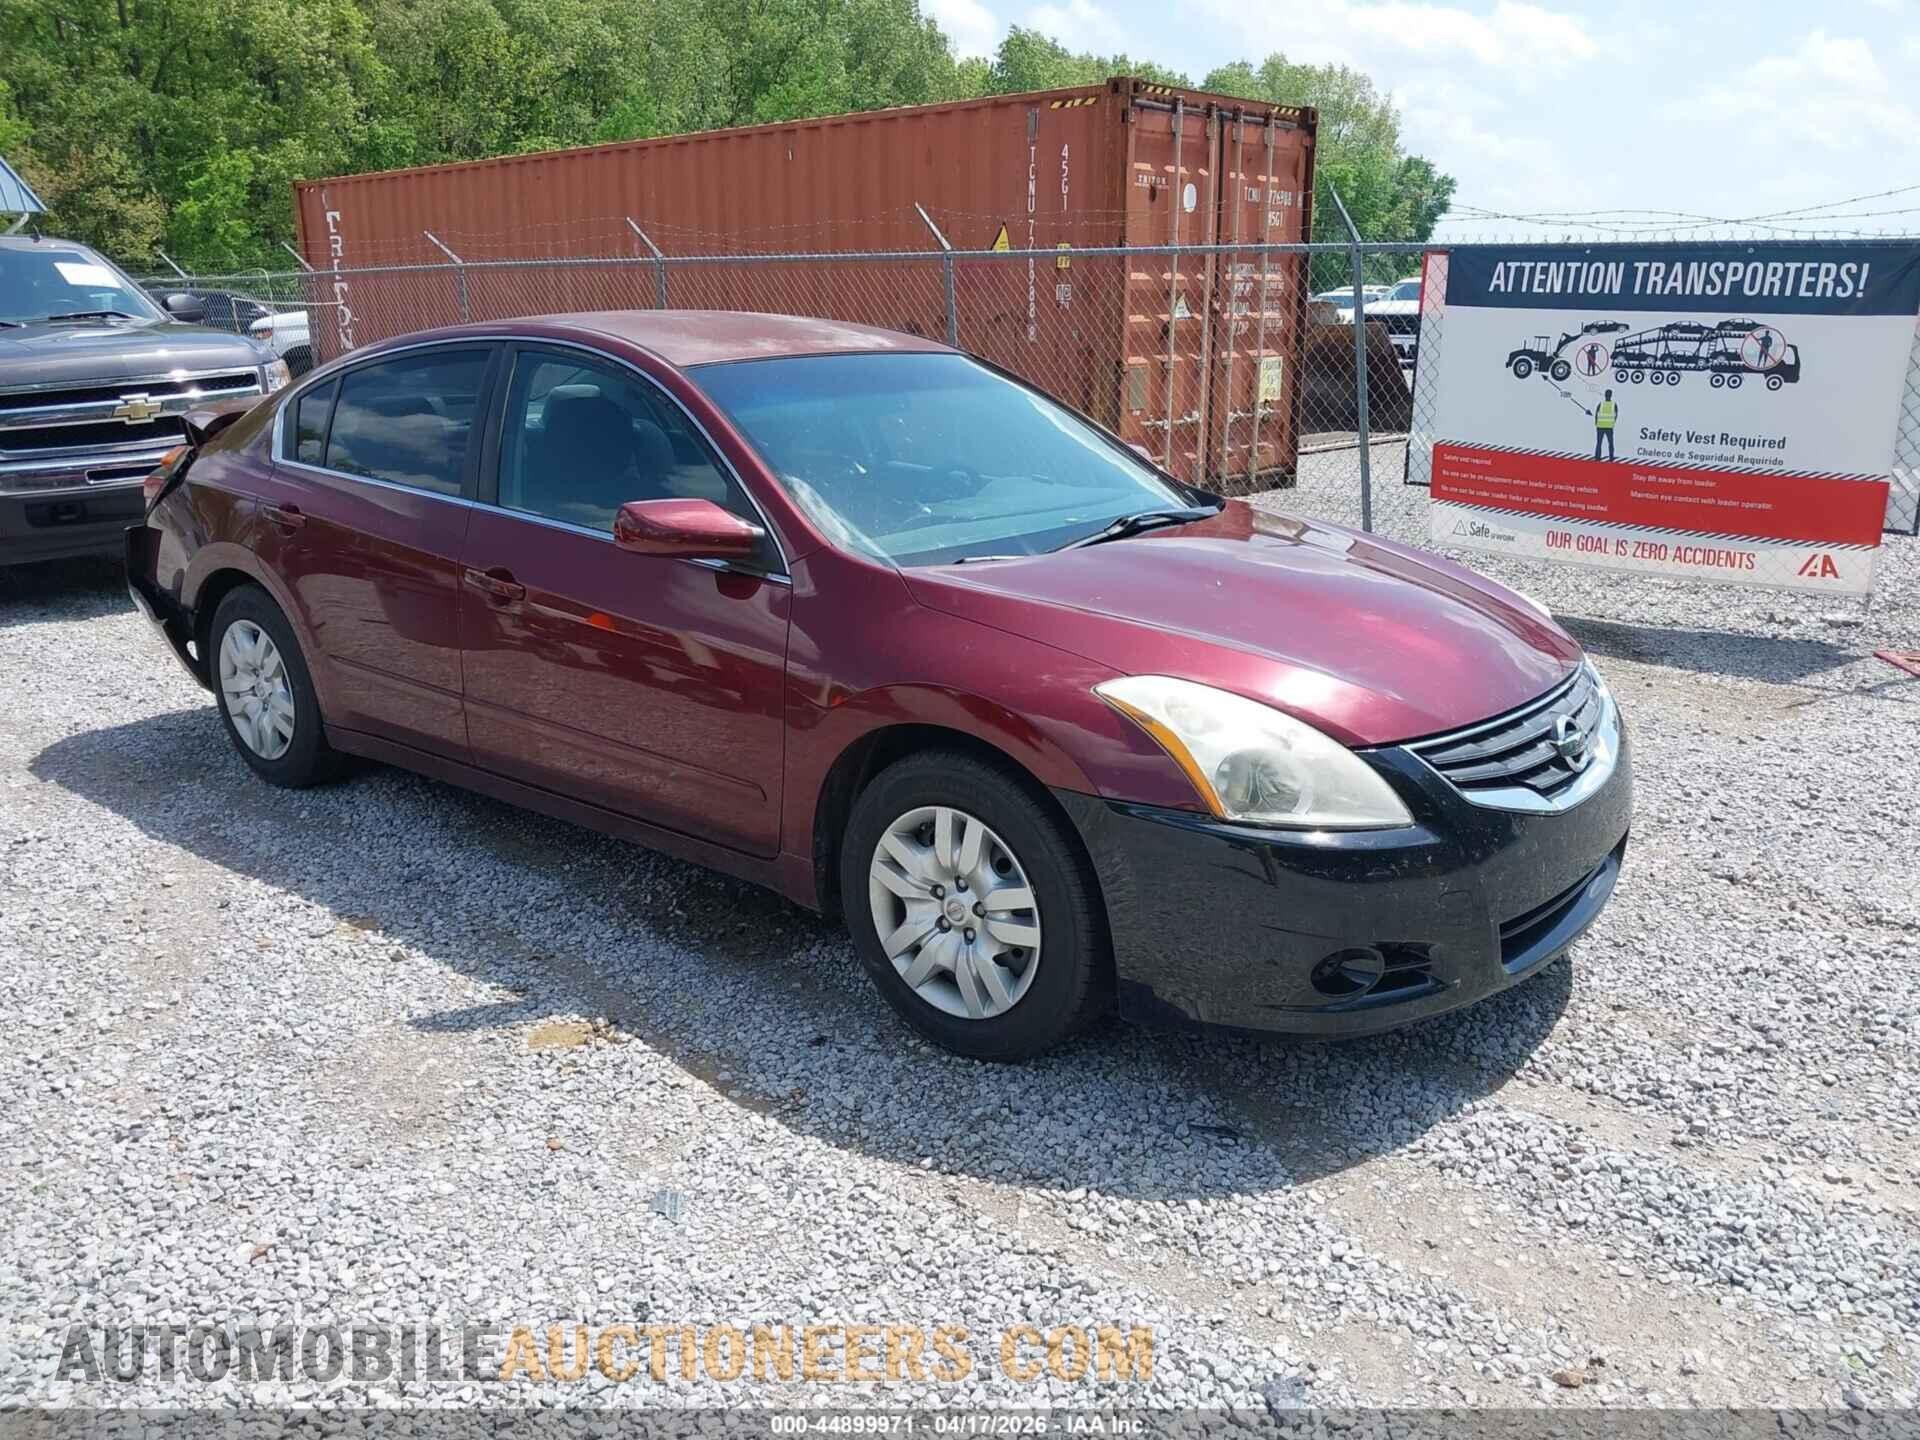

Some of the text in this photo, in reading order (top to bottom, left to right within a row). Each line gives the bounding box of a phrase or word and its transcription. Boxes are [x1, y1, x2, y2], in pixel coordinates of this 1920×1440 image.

[1488, 261, 1870, 298] ATTENTION TRANSPORTERS!
[1639, 427, 1787, 451] Safety Vest Required
[1637, 447, 1673, 459] Chaleco
[1674, 449, 1685, 460] de
[1688, 451, 1735, 464] Seguridad
[1468, 521, 1490, 538] Safe
[1546, 530, 1756, 570] OUR GOAL IS ZERO ACCIDENTS
